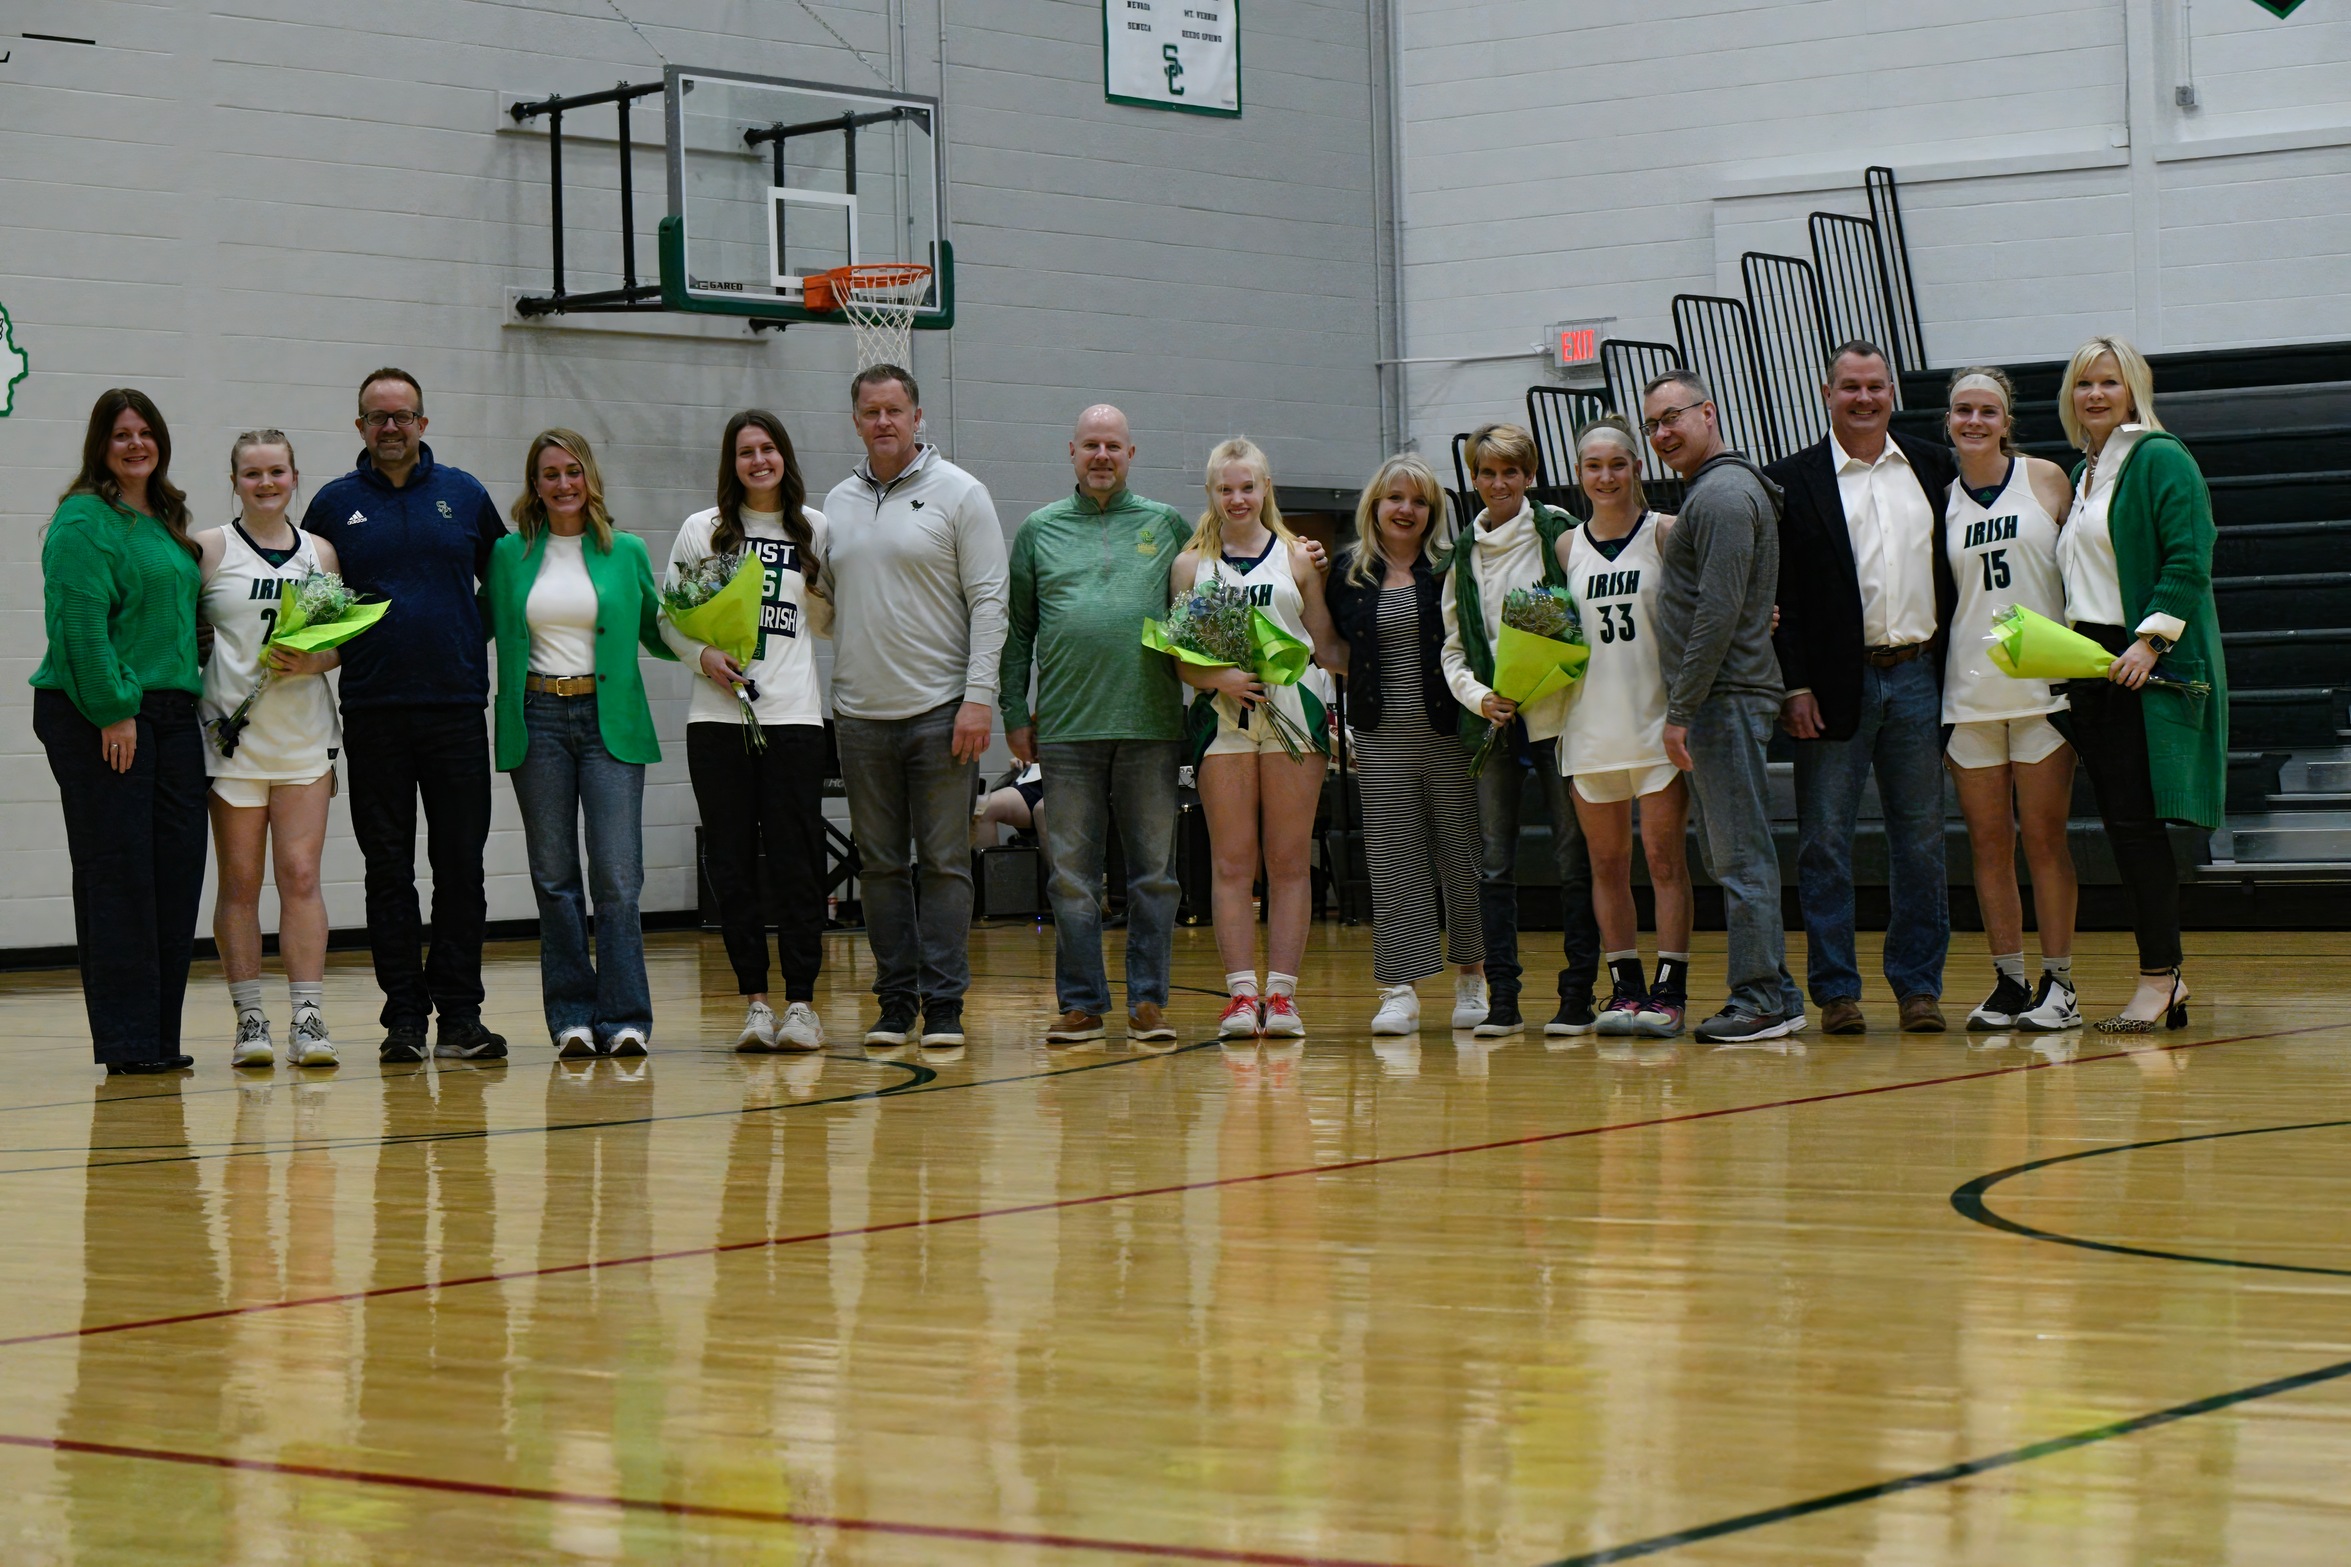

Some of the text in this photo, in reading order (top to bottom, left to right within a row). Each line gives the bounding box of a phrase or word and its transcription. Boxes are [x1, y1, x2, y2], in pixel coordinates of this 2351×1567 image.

[1127, 22, 1151, 32] SENECA
[709, 281, 743, 291] GARED
[1562, 329, 1595, 362] EXIT
[1964, 515, 2018, 549] IRISH
[1586, 570, 1641, 600] IRISH
[1979, 549, 2011, 591] 15
[248, 578, 299, 600] IRI
[261, 607, 281, 645] 2
[760, 605, 797, 632] IRISH
[1597, 603, 1635, 644] 33
